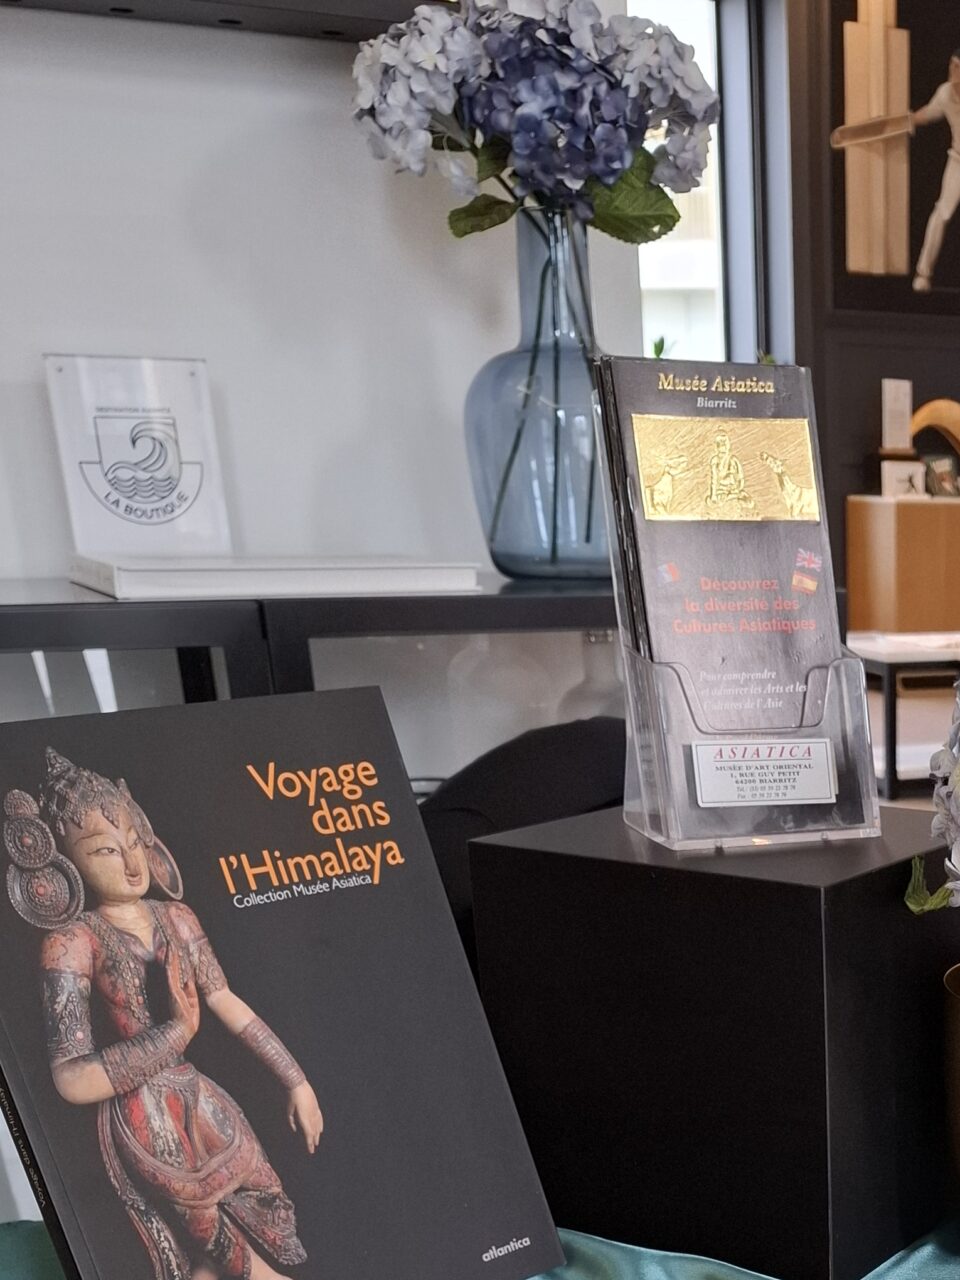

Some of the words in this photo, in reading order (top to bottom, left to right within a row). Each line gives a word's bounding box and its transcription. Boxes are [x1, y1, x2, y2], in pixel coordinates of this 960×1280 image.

[657, 372, 708, 392] Musée
[710, 374, 776, 394] Asiatica
[696, 397, 737, 409] Biarritz
[104, 491, 120, 509] LA
[123, 490, 189, 519] BOUTIQUE
[700, 576, 779, 591] Découvrez
[684, 598, 701, 612] la
[704, 597, 770, 613] diversité
[773, 596, 801, 611] des
[672, 618, 735, 633] Cultures
[739, 616, 816, 634] Asiatiques
[722, 668, 777, 684] comprendre
[763, 682, 783, 694] Arts
[785, 683, 794, 693] et
[795, 681, 807, 692] les
[763, 698, 783, 709] Asie
[713, 745, 813, 760] ASIATICA
[246, 760, 379, 807] Voyage
[311, 798, 391, 835] dans
[218, 837, 405, 894] l'Himalaya
[233, 889, 292, 908] Collection
[292, 881, 330, 897] Musée
[332, 873, 373, 891] Asiatica
[482, 1237, 531, 1262] atlantica
